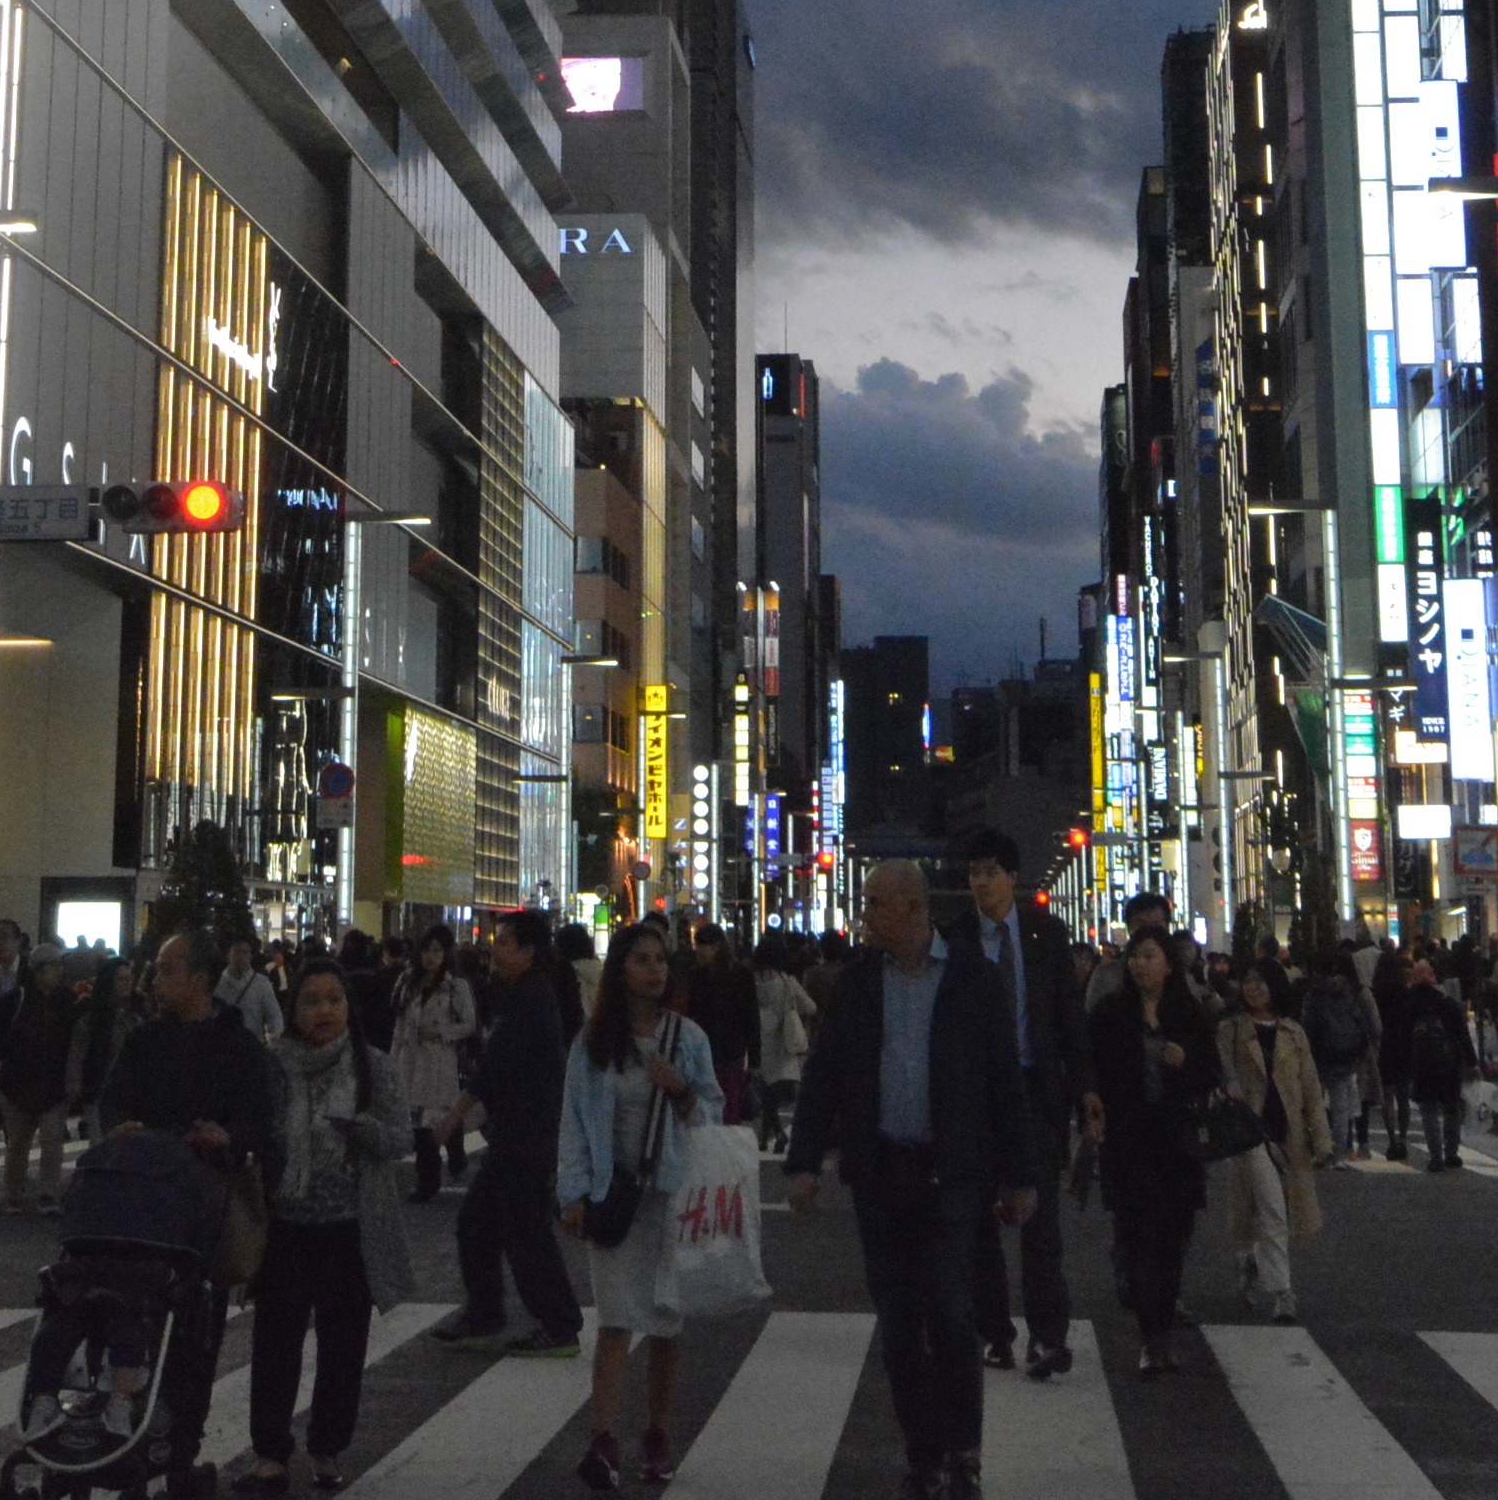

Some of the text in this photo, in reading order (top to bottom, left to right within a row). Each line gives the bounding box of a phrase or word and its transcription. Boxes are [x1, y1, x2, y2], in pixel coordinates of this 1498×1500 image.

[560, 227, 634, 254] RA
[1415, 571, 1443, 674] ヨシノヤ
